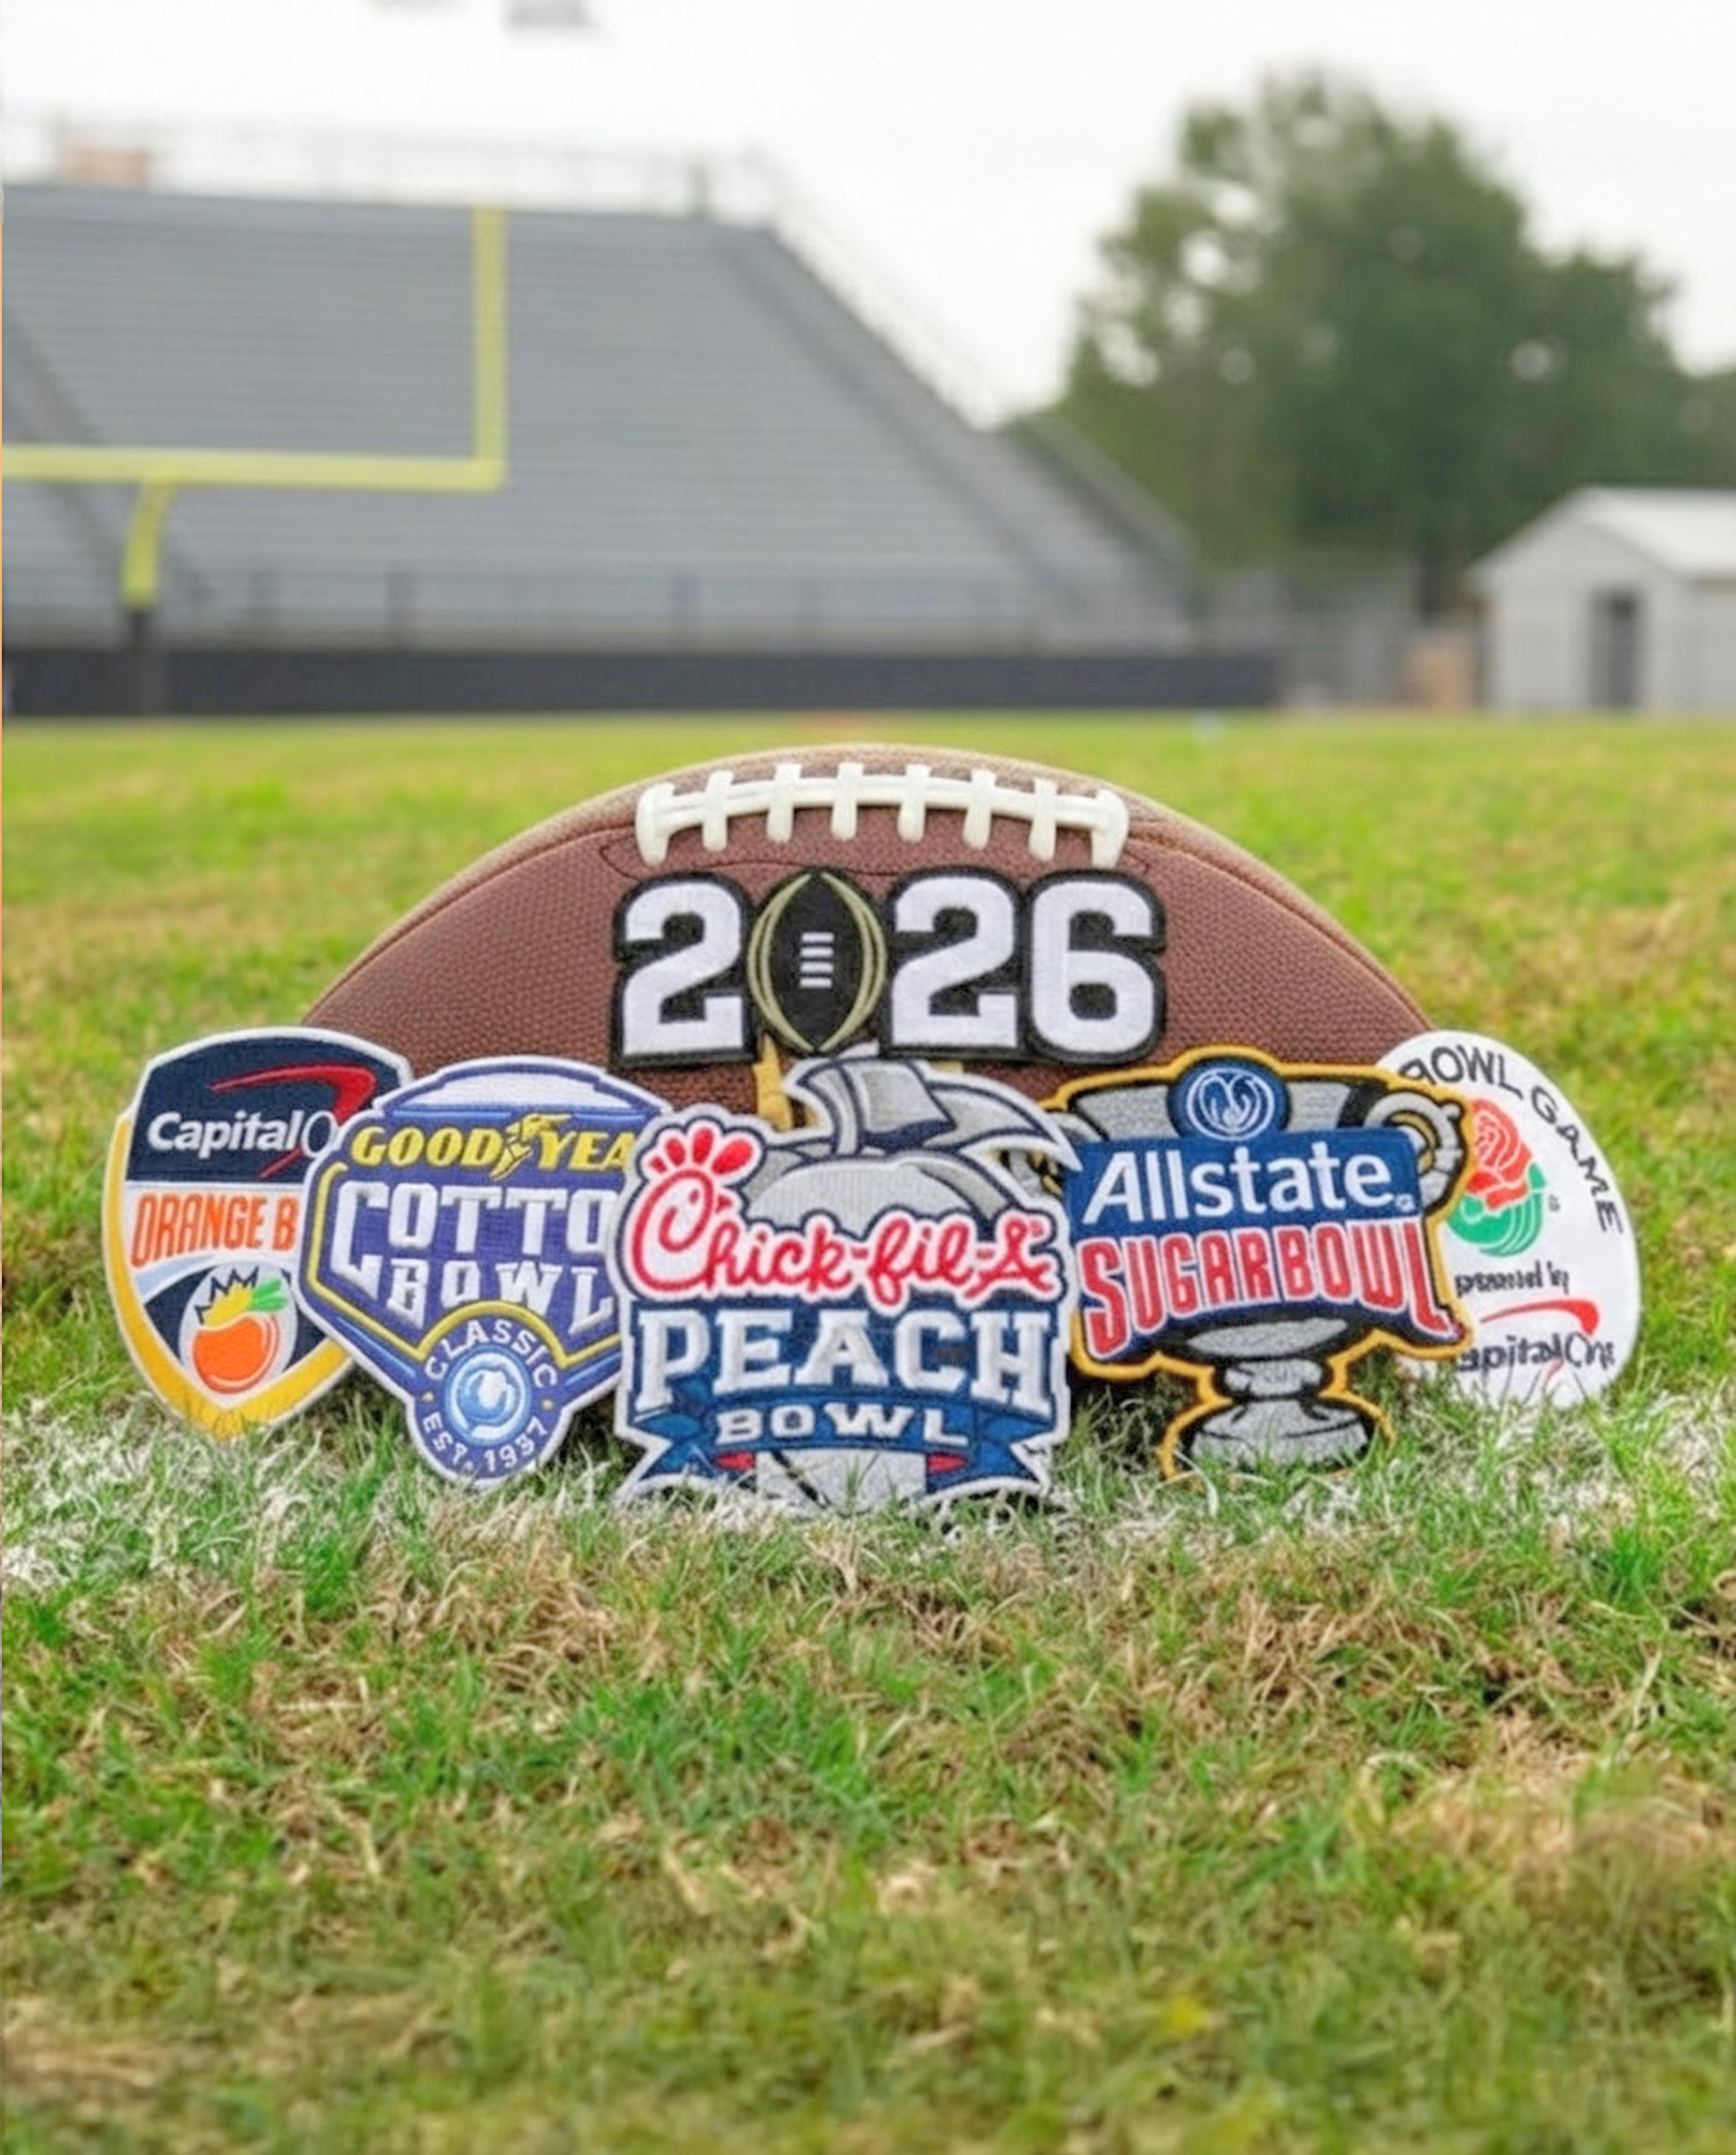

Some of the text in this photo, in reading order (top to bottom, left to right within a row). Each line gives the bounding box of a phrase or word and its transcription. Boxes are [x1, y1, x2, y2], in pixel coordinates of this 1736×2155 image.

[621, 873, 1155, 1055] 2026
[1082, 1141, 1394, 1224] Allstate
[1531, 1086, 1624, 1235] GAME
[131, 1193, 268, 1268] ORANGE
[330, 1180, 619, 1300] COTTO
[386, 1258, 614, 1335] BOWL
[425, 1319, 557, 1389] CLASSIC
[636, 1309, 1050, 1415] PEACH
[716, 1403, 968, 1446] BOWL
